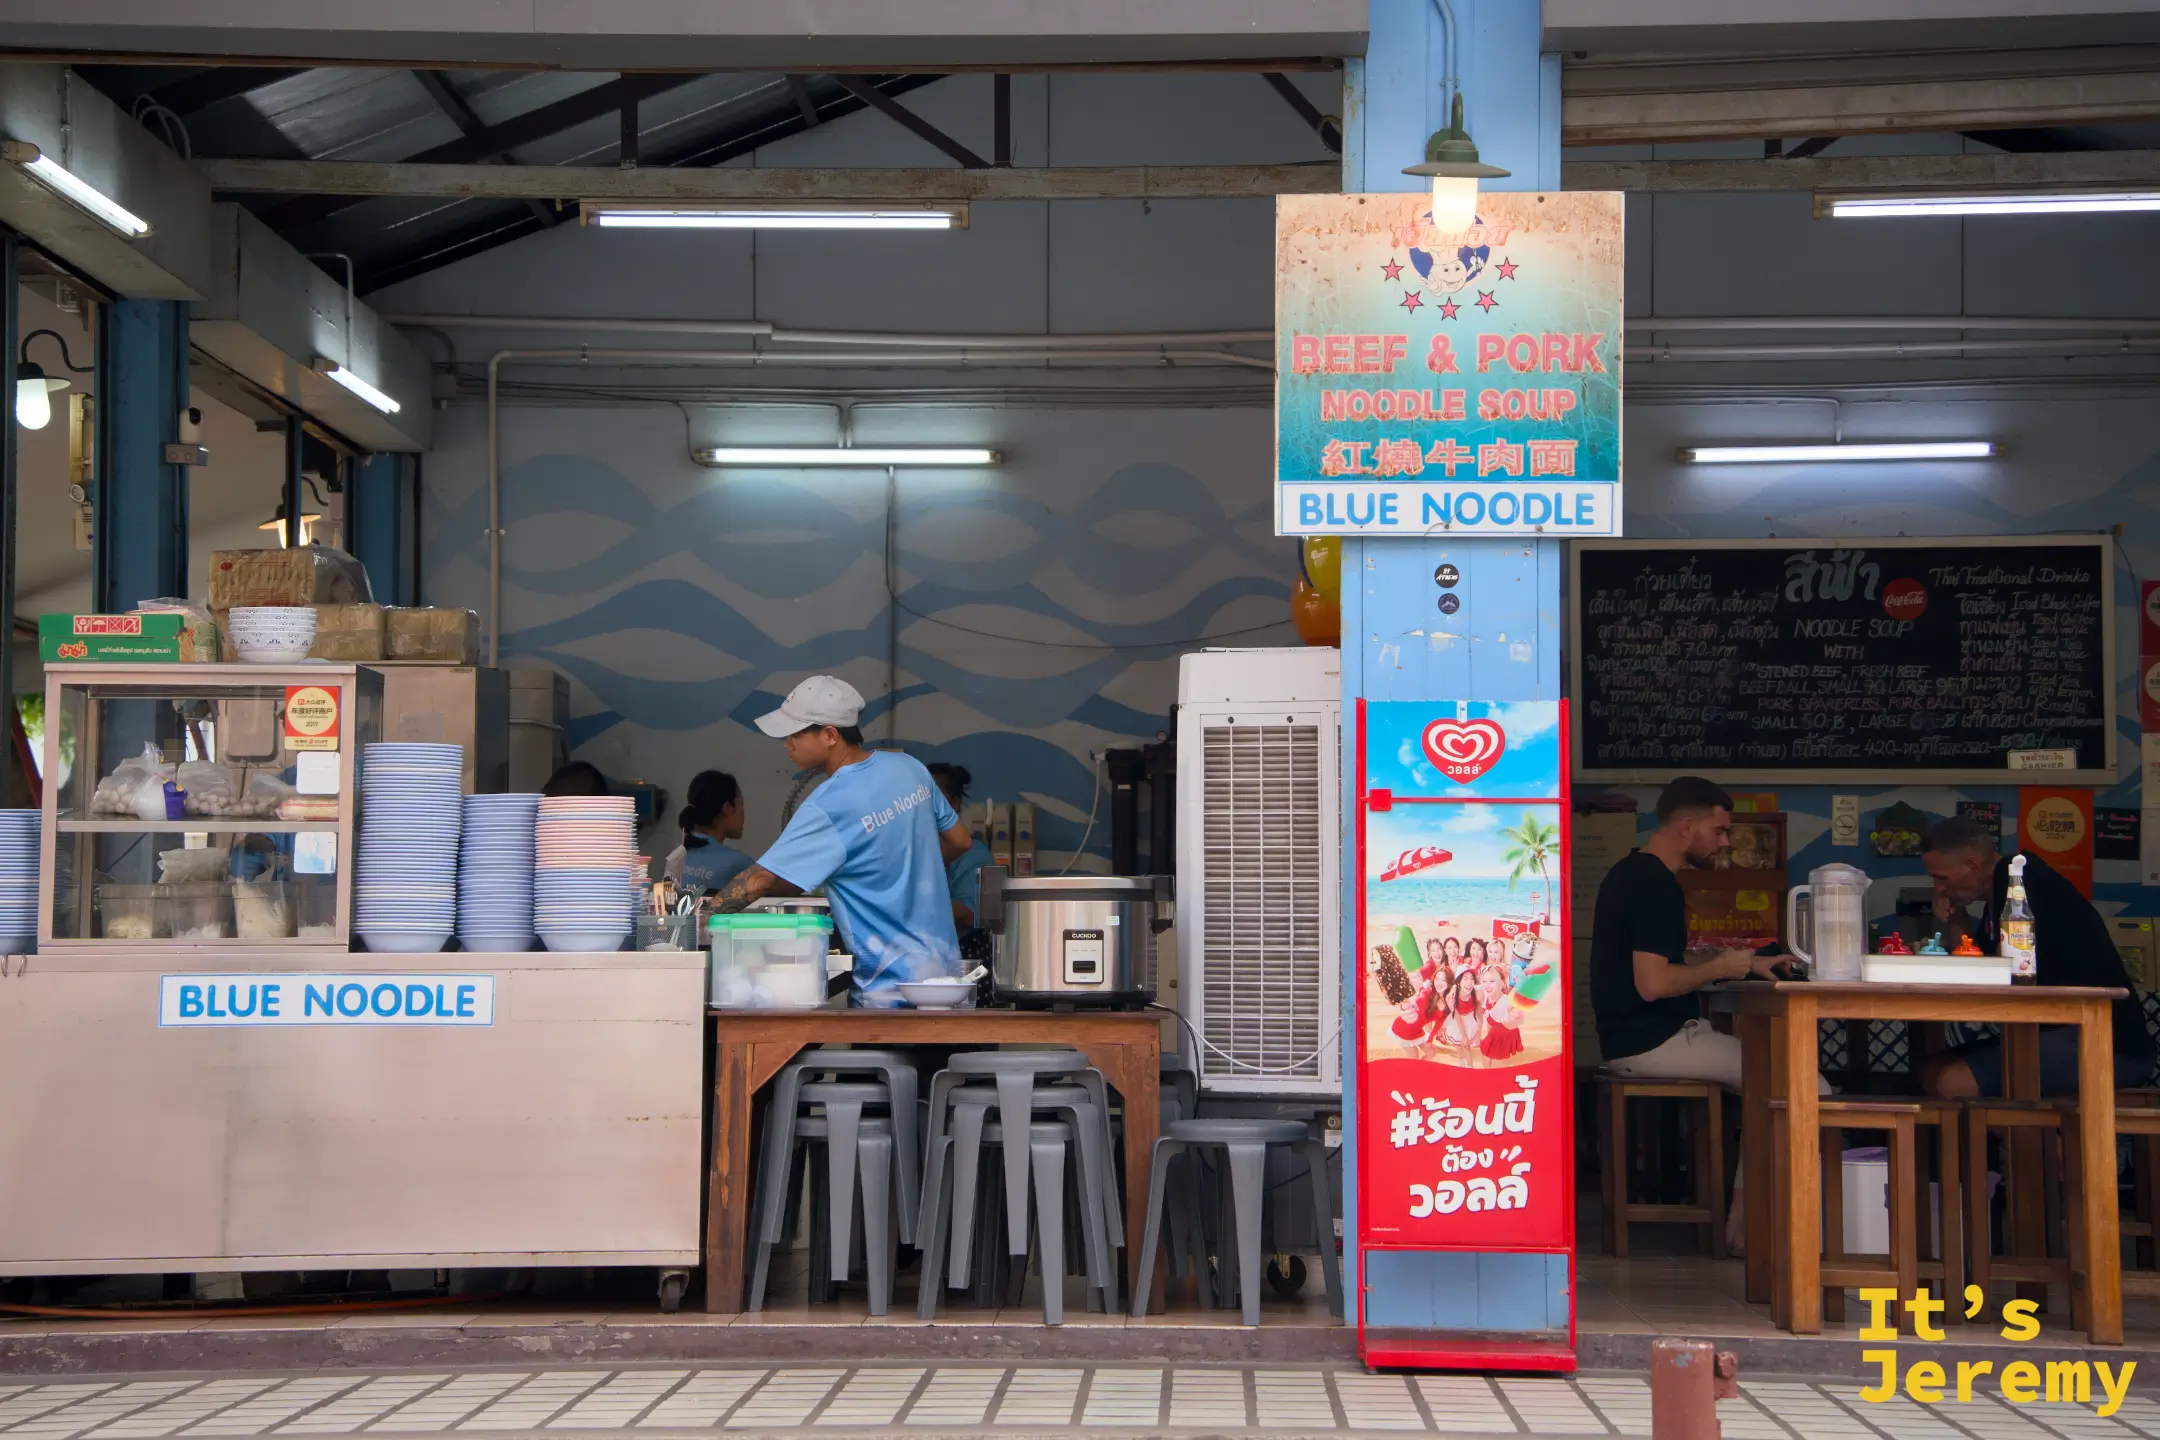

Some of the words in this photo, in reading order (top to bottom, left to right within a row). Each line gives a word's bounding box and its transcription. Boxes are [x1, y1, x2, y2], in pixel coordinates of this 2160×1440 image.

[1291, 334, 1408, 374] BEEF
[1426, 334, 1461, 374] &
[1476, 332, 1607, 374] PORK
[1321, 389, 1466, 422] NOODLE
[1478, 389, 1576, 422] SOUP
[1299, 492, 1399, 526] BLUE
[1422, 491, 1595, 526] NOODLE
[1929, 566, 1961, 587] Thai
[1794, 618, 1864, 640] NOODLE
[1867, 618, 1915, 639] SOUP
[1824, 643, 1865, 661] WITH
[1896, 665, 1931, 678] BEEF
[1752, 715, 1799, 730] SMALL
[1859, 714, 1909, 729] LARGE
[2020, 762, 2065, 770] CASHIER
[861, 807, 895, 833] Blue
[893, 784, 932, 815] Noodle
[179, 984, 280, 1017] BLUE
[304, 983, 476, 1017] NOODLE
[1442, 1144, 1494, 1173] ต้อง
[1409, 1162, 1531, 1218] วอลล์
